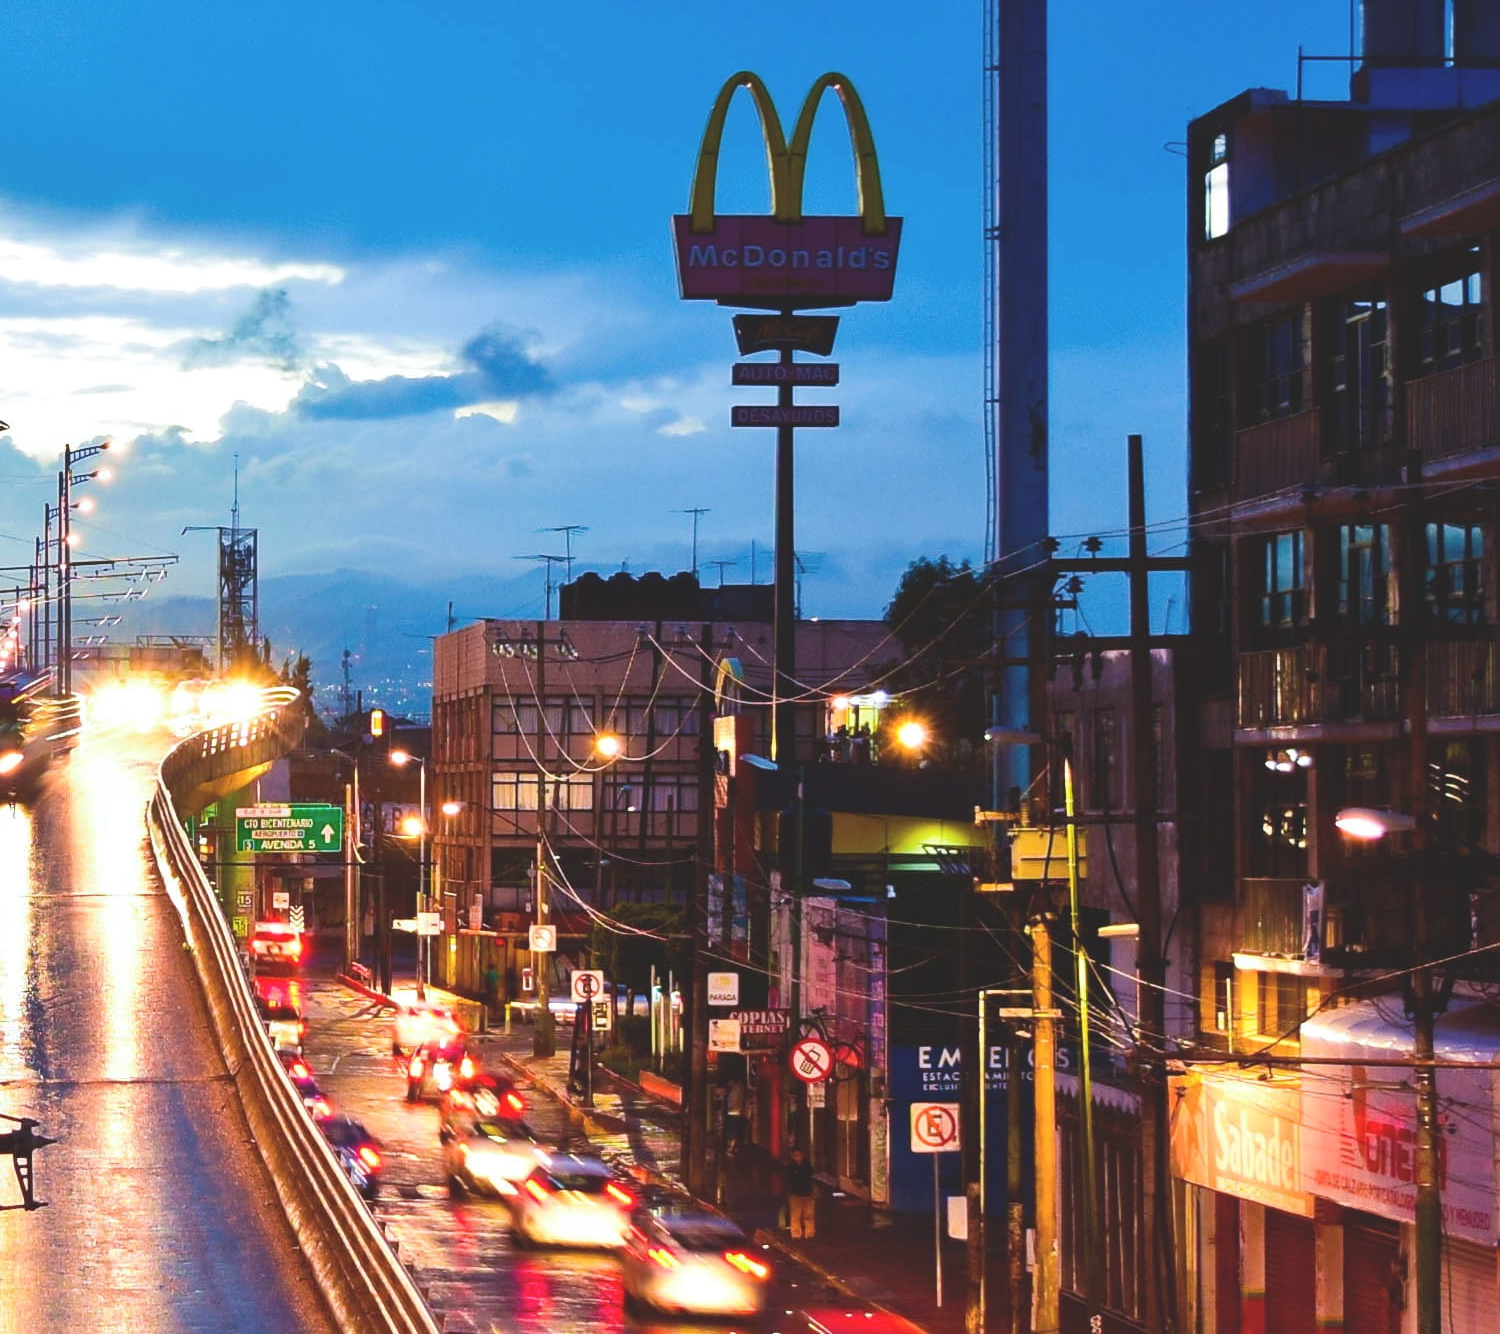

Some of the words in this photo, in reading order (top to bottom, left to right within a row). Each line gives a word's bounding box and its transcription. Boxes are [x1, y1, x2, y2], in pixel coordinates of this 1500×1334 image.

[688, 245, 891, 270] McDonald's
[738, 410, 835, 423] DESAYUNOS
[244, 819, 258, 828] CTO
[261, 819, 313, 828] BICENTENARIO
[261, 840, 304, 849] AVENIDA
[742, 1024, 785, 1033] TERNET
